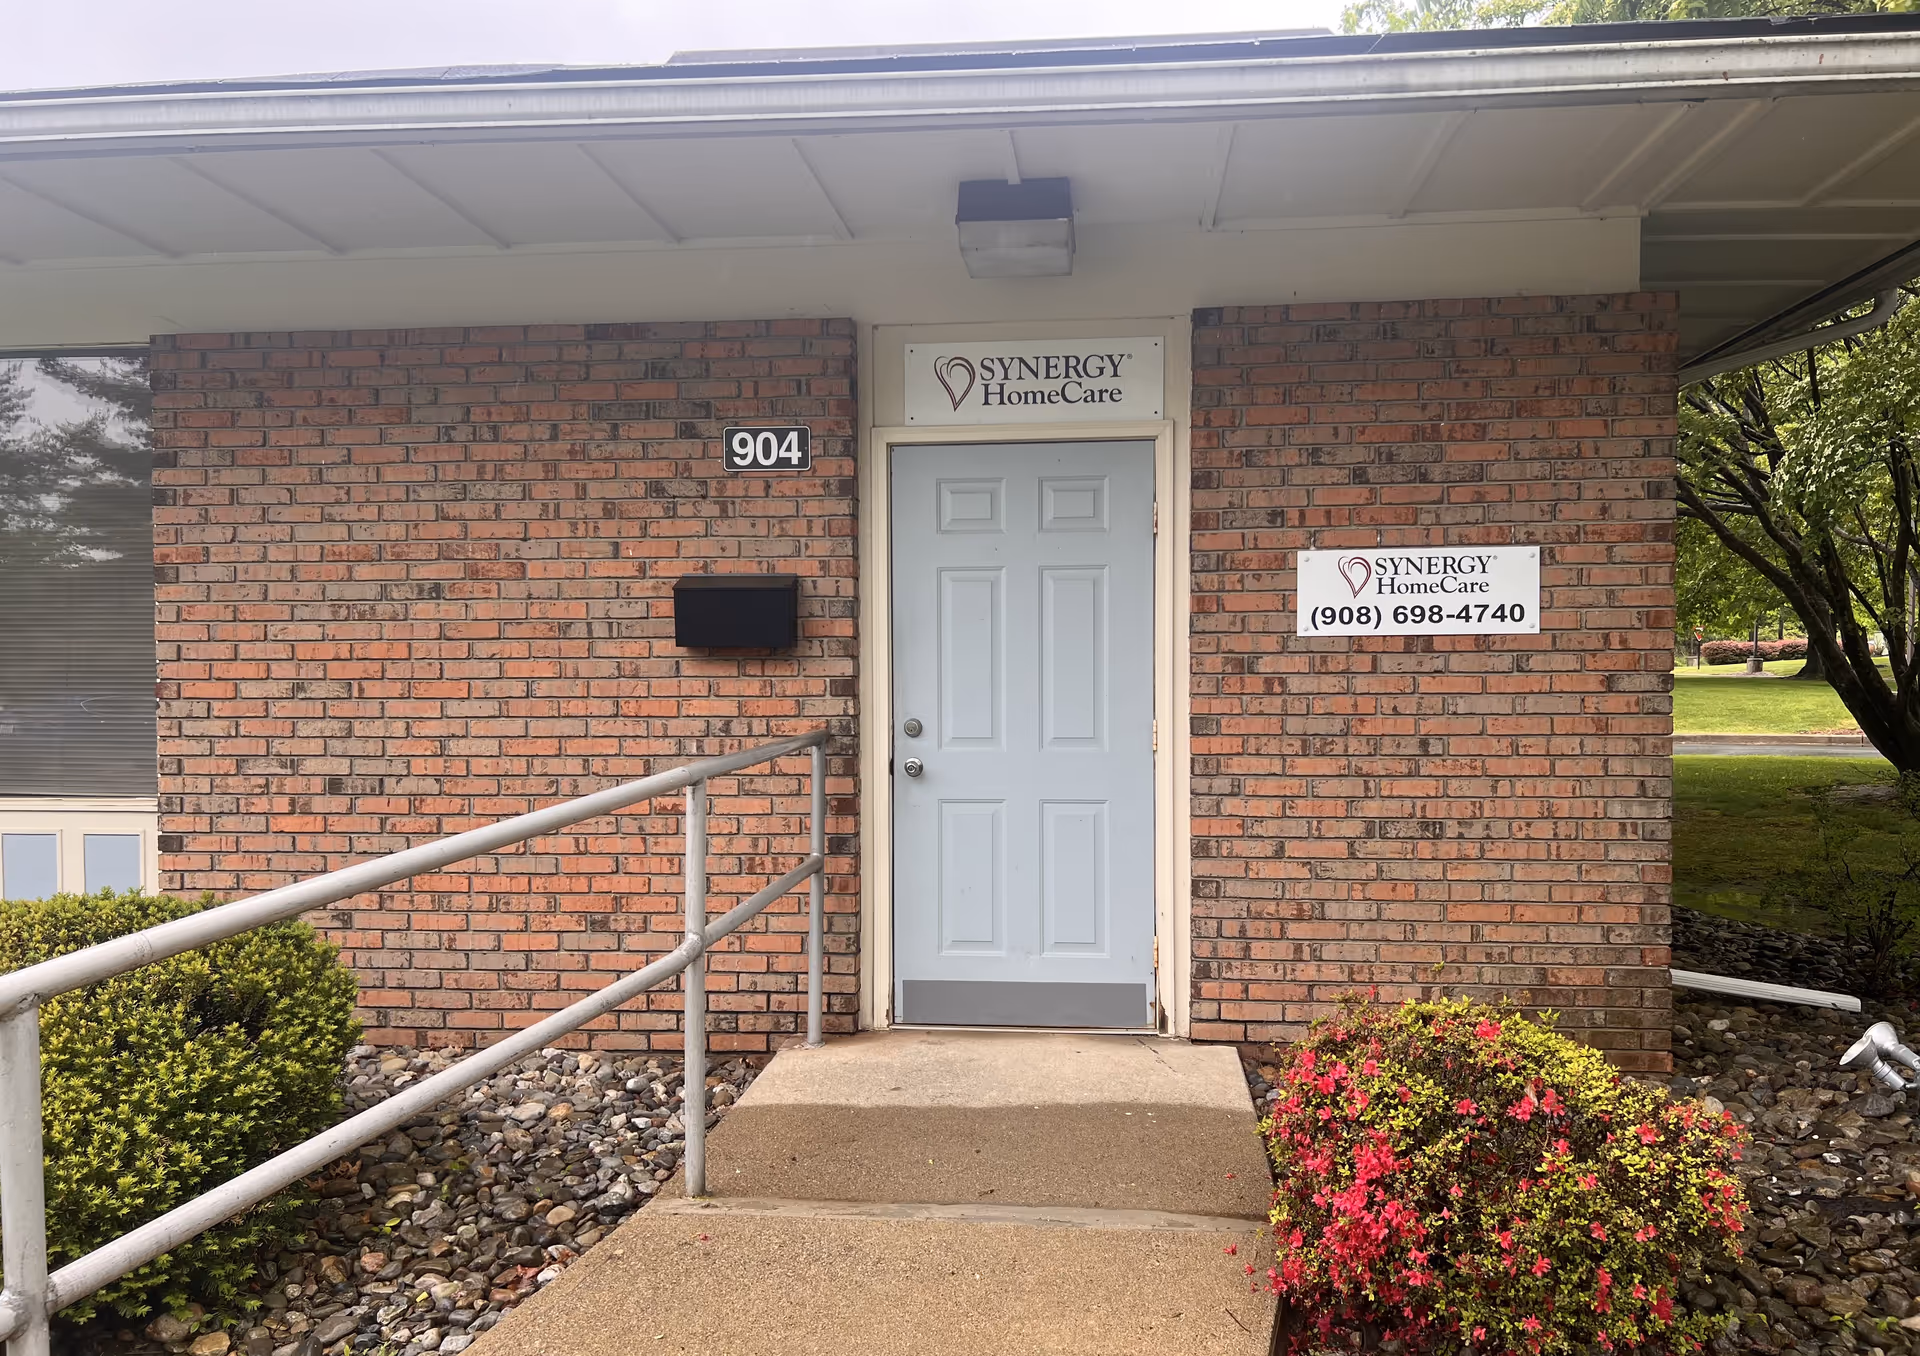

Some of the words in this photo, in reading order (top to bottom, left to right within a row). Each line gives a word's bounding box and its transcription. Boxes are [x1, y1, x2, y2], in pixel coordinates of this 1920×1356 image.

[982, 381, 1123, 406] HomeCare
[732, 431, 802, 466] 904
[1376, 576, 1490, 595] HomeCare
[1311, 605, 1382, 630] (908)
[1392, 603, 1525, 625] 698-4740
